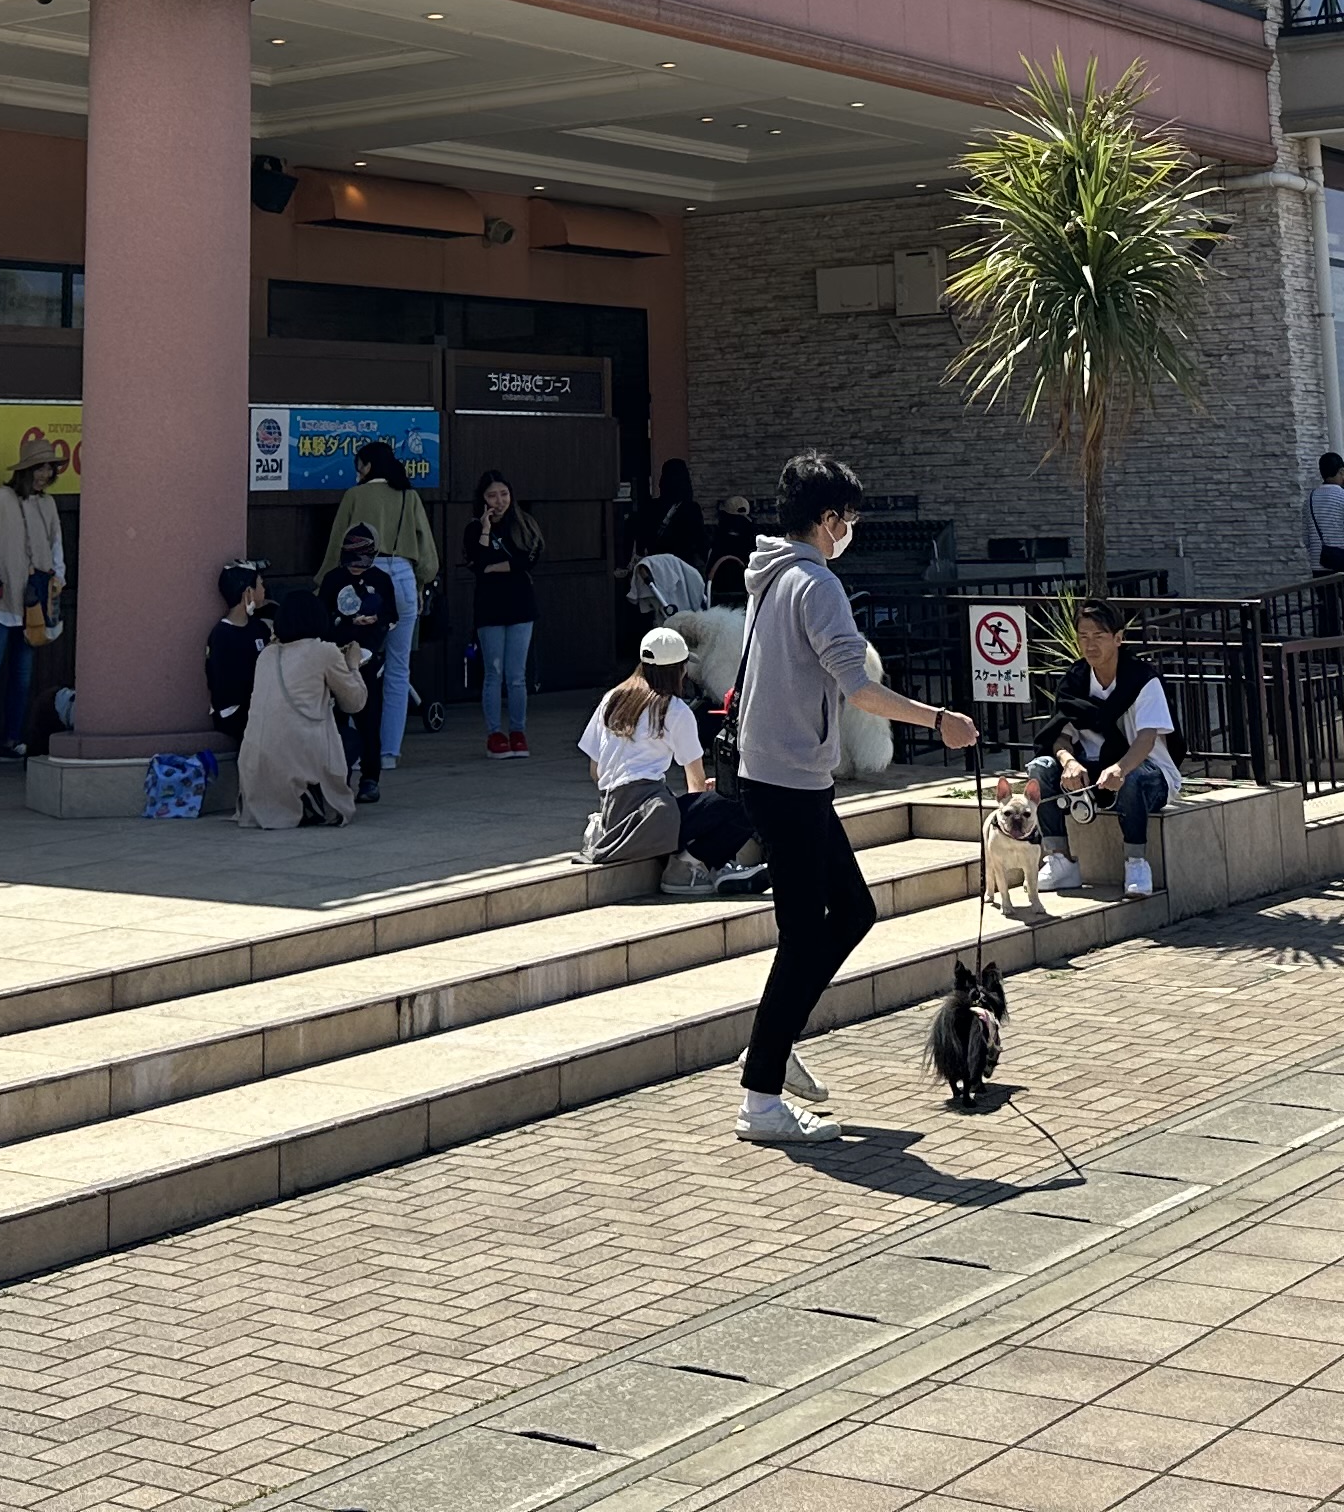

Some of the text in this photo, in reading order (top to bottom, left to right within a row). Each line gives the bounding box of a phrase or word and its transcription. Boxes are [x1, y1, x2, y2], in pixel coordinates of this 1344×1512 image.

[256, 459, 283, 473] PADI
[974, 669, 1026, 682] スケートボード
[987, 682, 1015, 697] 禁止
